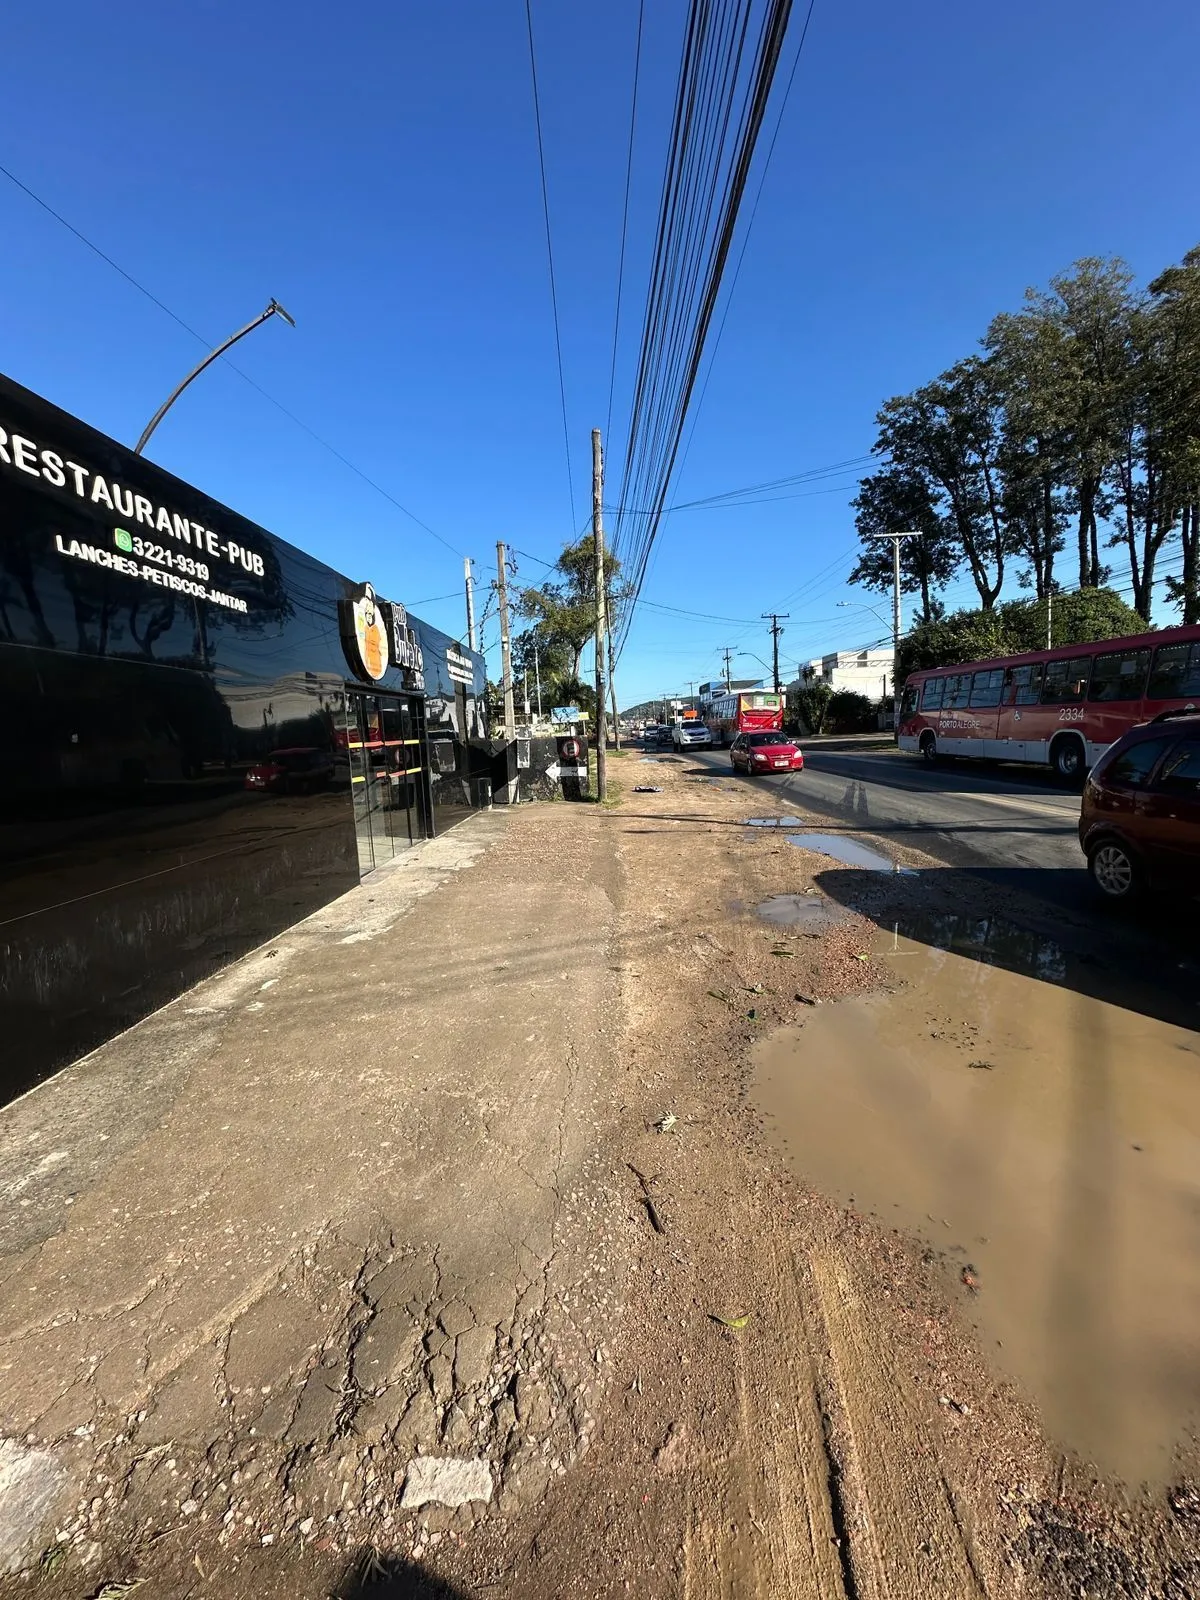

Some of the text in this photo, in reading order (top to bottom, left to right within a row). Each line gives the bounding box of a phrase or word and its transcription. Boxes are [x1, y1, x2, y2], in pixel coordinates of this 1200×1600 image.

[55, 534, 248, 614] LANCHES-PETISCOS-JANTAR
[132, 536, 210, 581] 3221-9319
[1058, 707, 1085, 721] 2334
